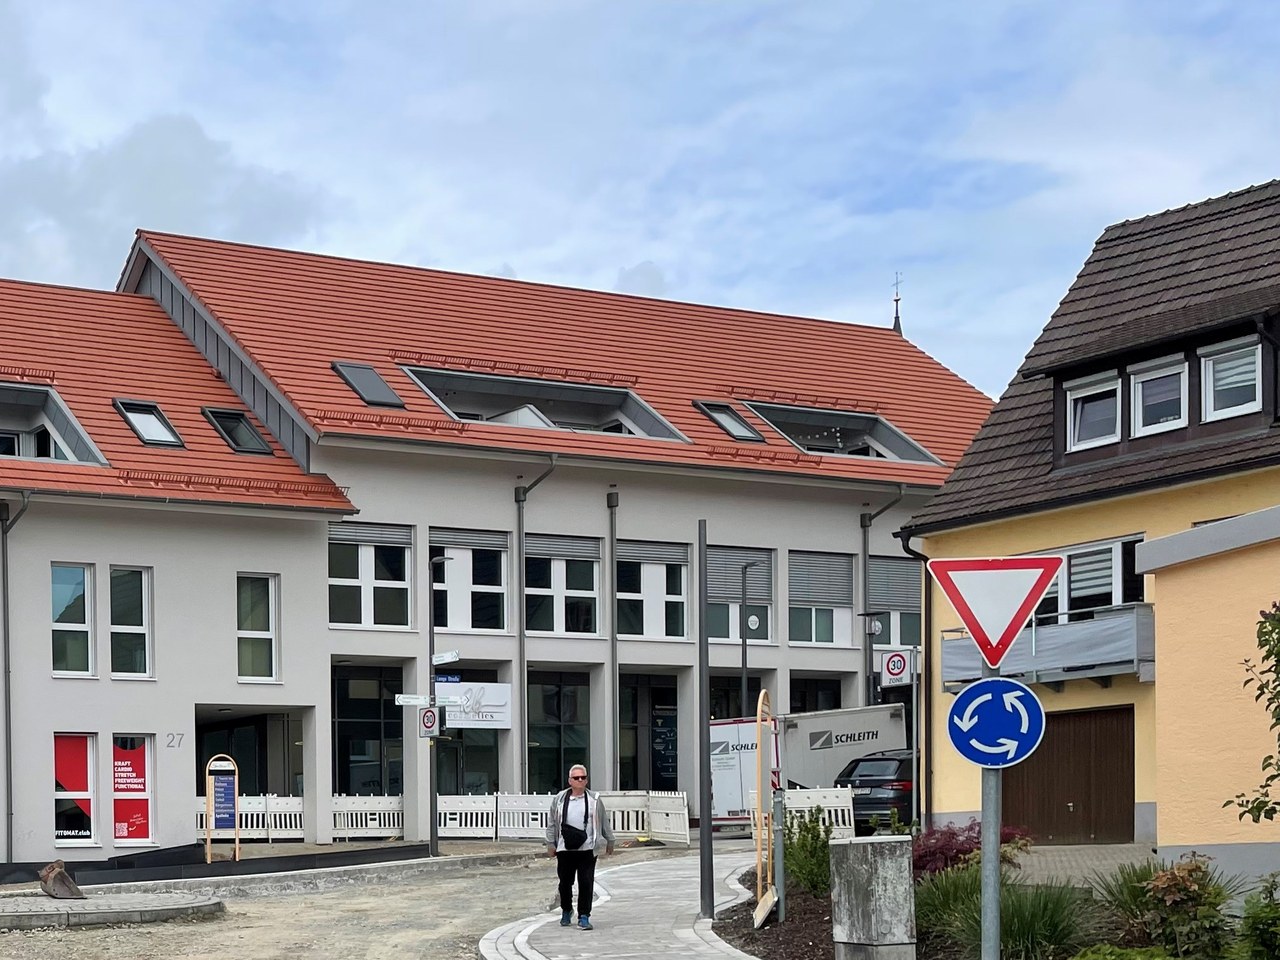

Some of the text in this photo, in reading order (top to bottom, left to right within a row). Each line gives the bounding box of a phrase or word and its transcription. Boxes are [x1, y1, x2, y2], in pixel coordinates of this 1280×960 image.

[890, 659, 902, 671] 30
[426, 714, 434, 724] 30
[166, 733, 185, 748] 27
[834, 730, 878, 743] SCHLEITH
[730, 742, 758, 751] SCHLEI
